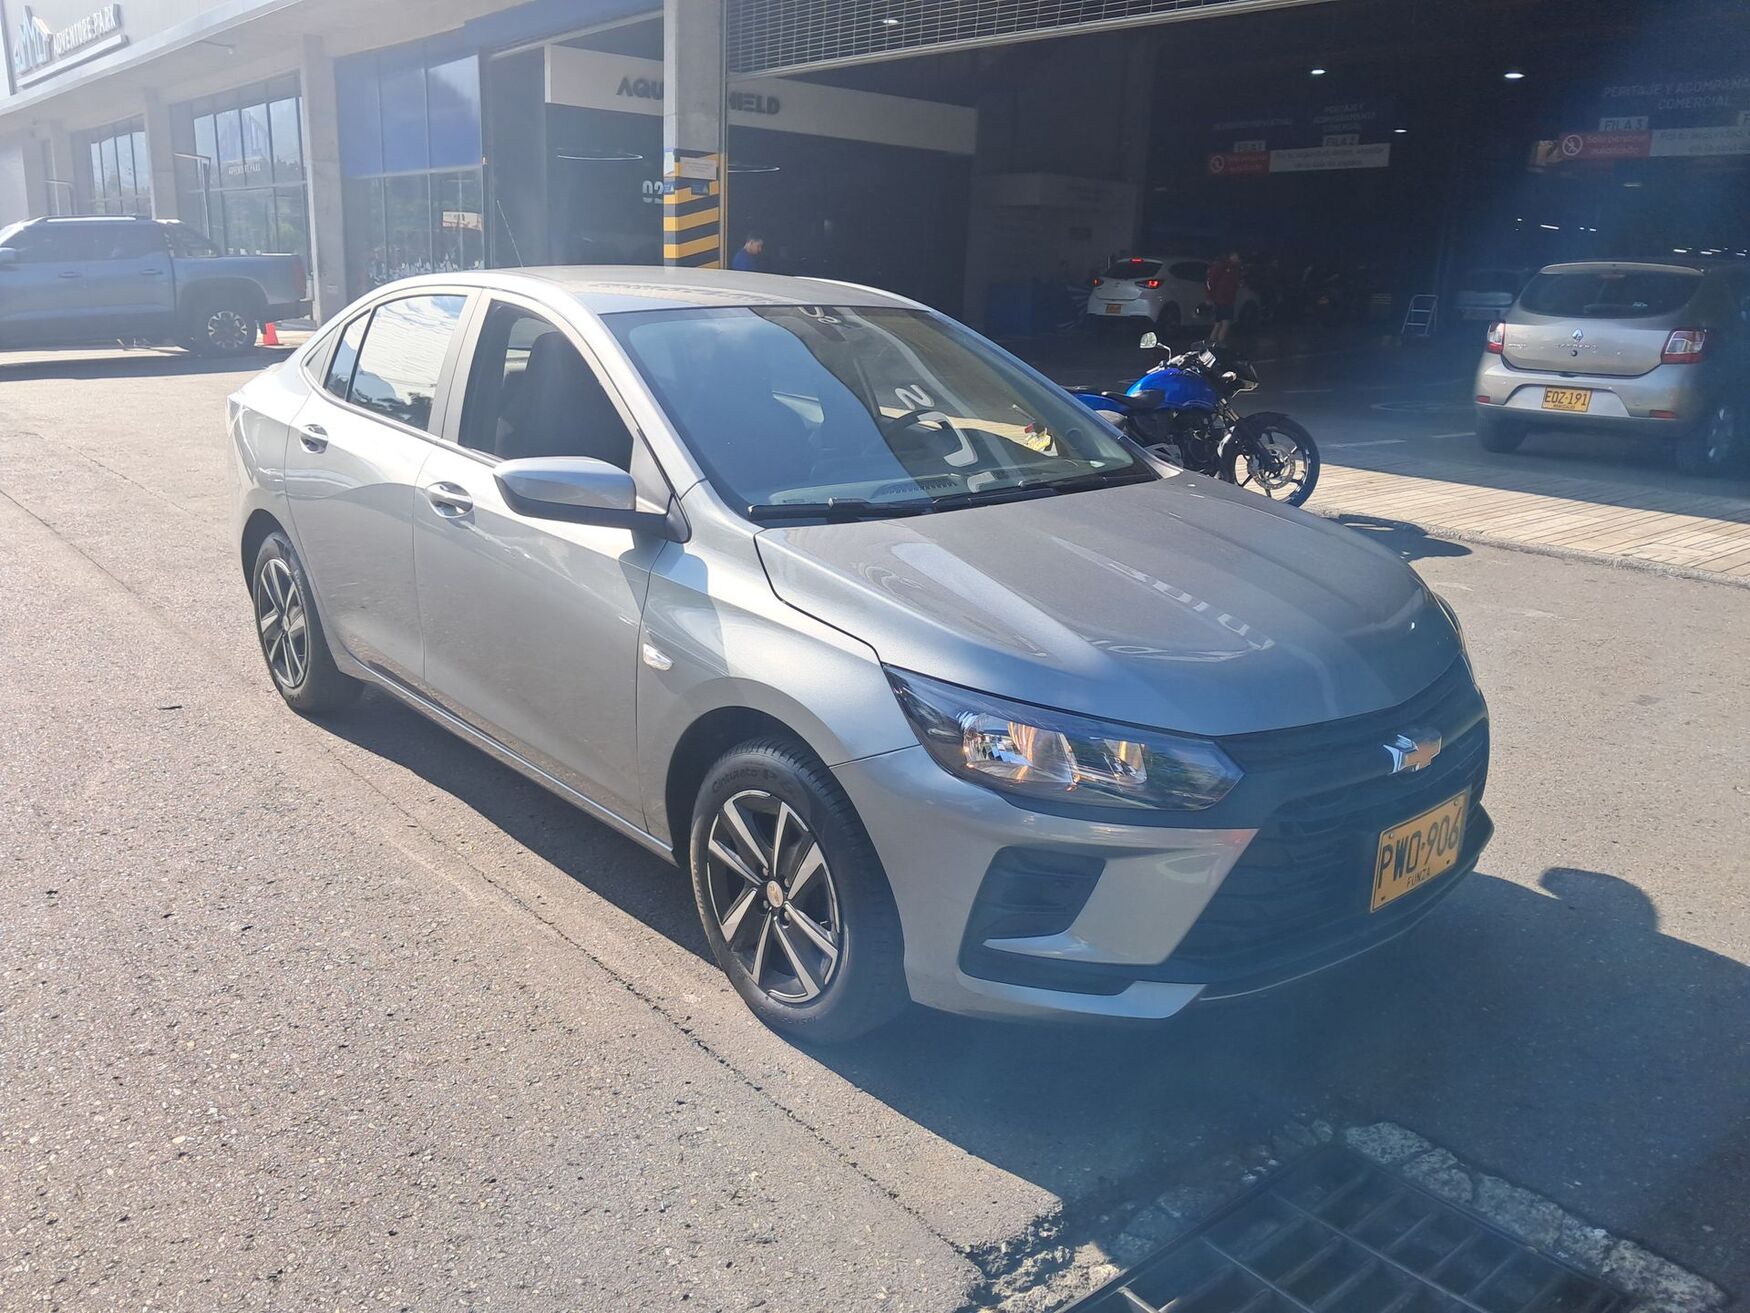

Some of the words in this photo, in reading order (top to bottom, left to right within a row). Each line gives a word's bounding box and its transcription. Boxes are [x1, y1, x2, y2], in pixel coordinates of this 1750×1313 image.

[53, 17, 93, 57] ADVENTURE
[93, 7, 116, 37] PARK
[1604, 118, 1633, 132] FILA
[1406, 867, 1431, 889] FUNZA
